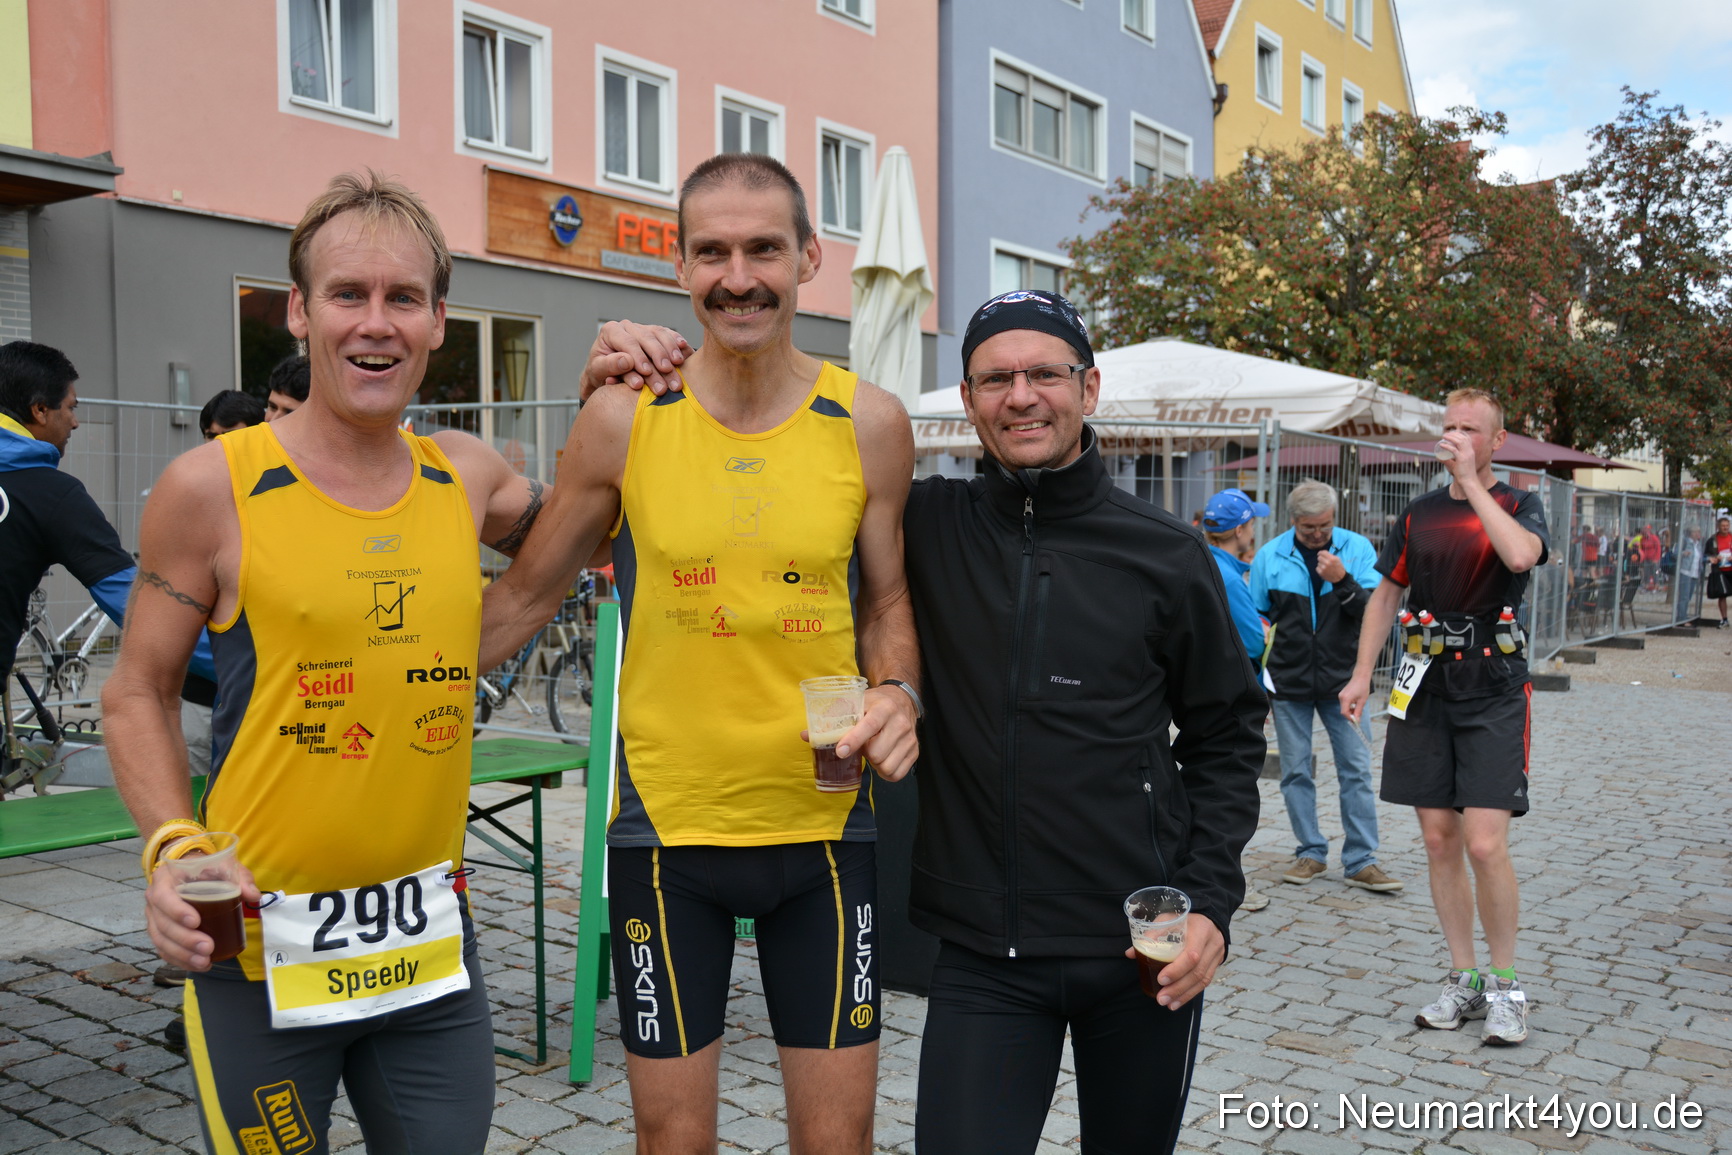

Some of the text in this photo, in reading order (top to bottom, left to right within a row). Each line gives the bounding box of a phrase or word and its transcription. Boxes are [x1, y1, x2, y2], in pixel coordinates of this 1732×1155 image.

[346, 567, 422, 580] FONDSZENTRUM
[672, 566, 717, 588] Seidl
[774, 602, 826, 622] PIZZERIA
[782, 619, 822, 633] ELIO
[367, 635, 421, 647] NEUMARKT
[297, 657, 353, 672] Schreinerei
[297, 672, 354, 698] Seidl
[304, 699, 345, 710] Berngau
[414, 705, 465, 730] PIZZERIA
[424, 724, 459, 743] ELIO
[341, 752, 369, 760] Berngau
[308, 875, 428, 952] 290
[275, 952, 284, 964] A
[327, 957, 420, 998] Speedy
[265, 1088, 310, 1151] Run!
